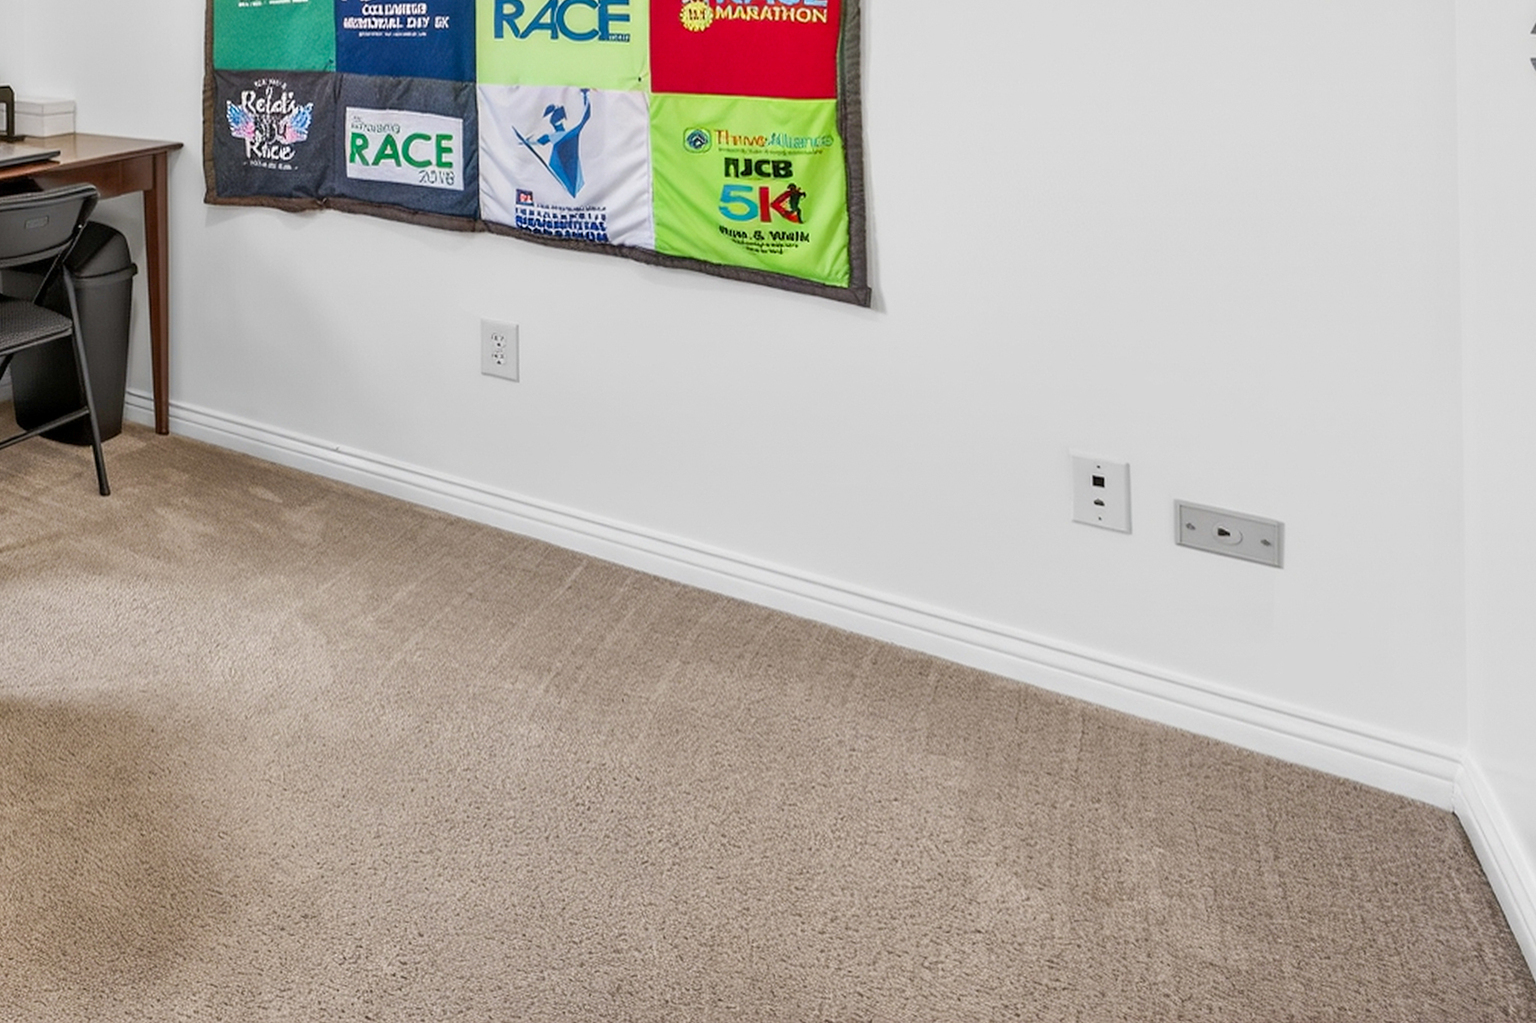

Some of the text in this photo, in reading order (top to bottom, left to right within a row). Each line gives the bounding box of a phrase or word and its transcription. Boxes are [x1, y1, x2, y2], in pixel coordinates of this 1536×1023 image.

[714, 4, 828, 24] MARATHON
[348, 131, 454, 168] RACE
[718, 183, 805, 224] 5K
